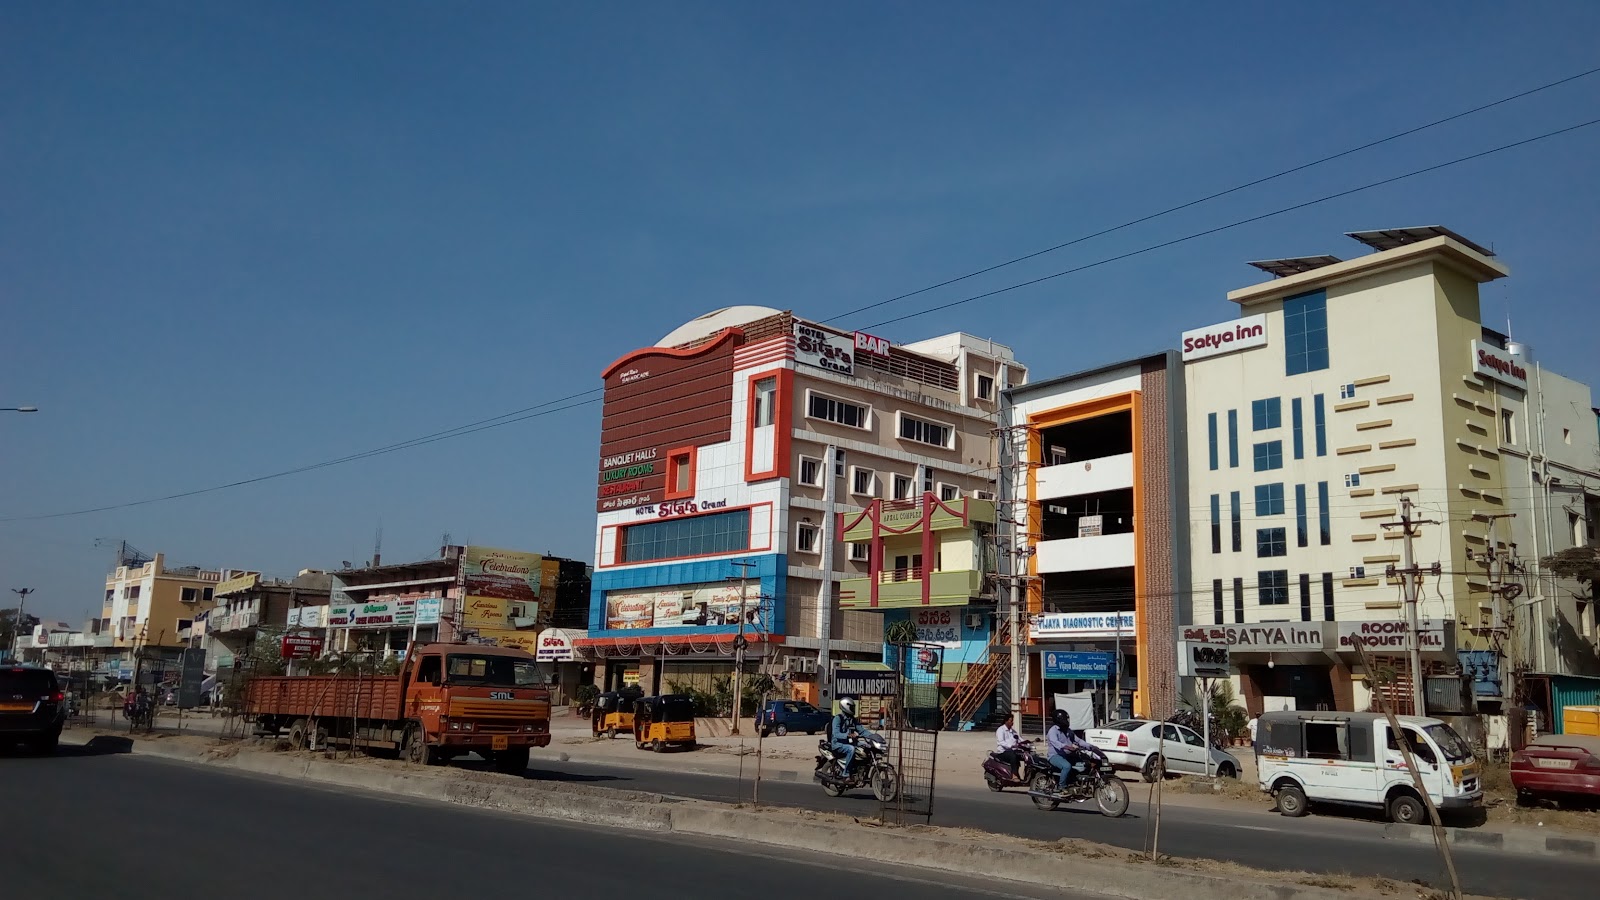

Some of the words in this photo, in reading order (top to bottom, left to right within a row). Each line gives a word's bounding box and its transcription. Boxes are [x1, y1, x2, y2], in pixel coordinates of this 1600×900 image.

[799, 325, 826, 340] HOTEL
[1184, 331, 1234, 353] Satya
[1236, 325, 1263, 341] inn
[797, 335, 852, 364] Sitara
[855, 332, 890, 357] BAR
[819, 357, 852, 374] Grand
[1478, 349, 1510, 376] Satya
[1510, 359, 1527, 381] inn
[603, 452, 634, 468] BANQUET
[634, 447, 657, 462] HALLS
[603, 467, 628, 481] LUXURY
[627, 463, 653, 477] ROOMS
[602, 480, 644, 496] RESTAURANT
[635, 505, 656, 516] HOTEL
[658, 501, 698, 518] Sitara
[701, 497, 727, 510] Grand
[480, 558, 530, 575] Celebrations
[480, 609, 503, 619] Rooms
[1038, 618, 1061, 630] VIJAYA
[1062, 616, 1104, 629] DIAGNOSTIC
[1105, 615, 1134, 628] CENTRE
[543, 637, 565, 648] Sitara
[1226, 628, 1288, 645] SATYA
[1290, 627, 1322, 645] inn
[1058, 661, 1072, 672] Vijaya
[1072, 661, 1093, 672] Diagnostic
[1093, 662, 1107, 671] Centre
[836, 678, 865, 695] VANAJA
[490, 691, 515, 700] SML
